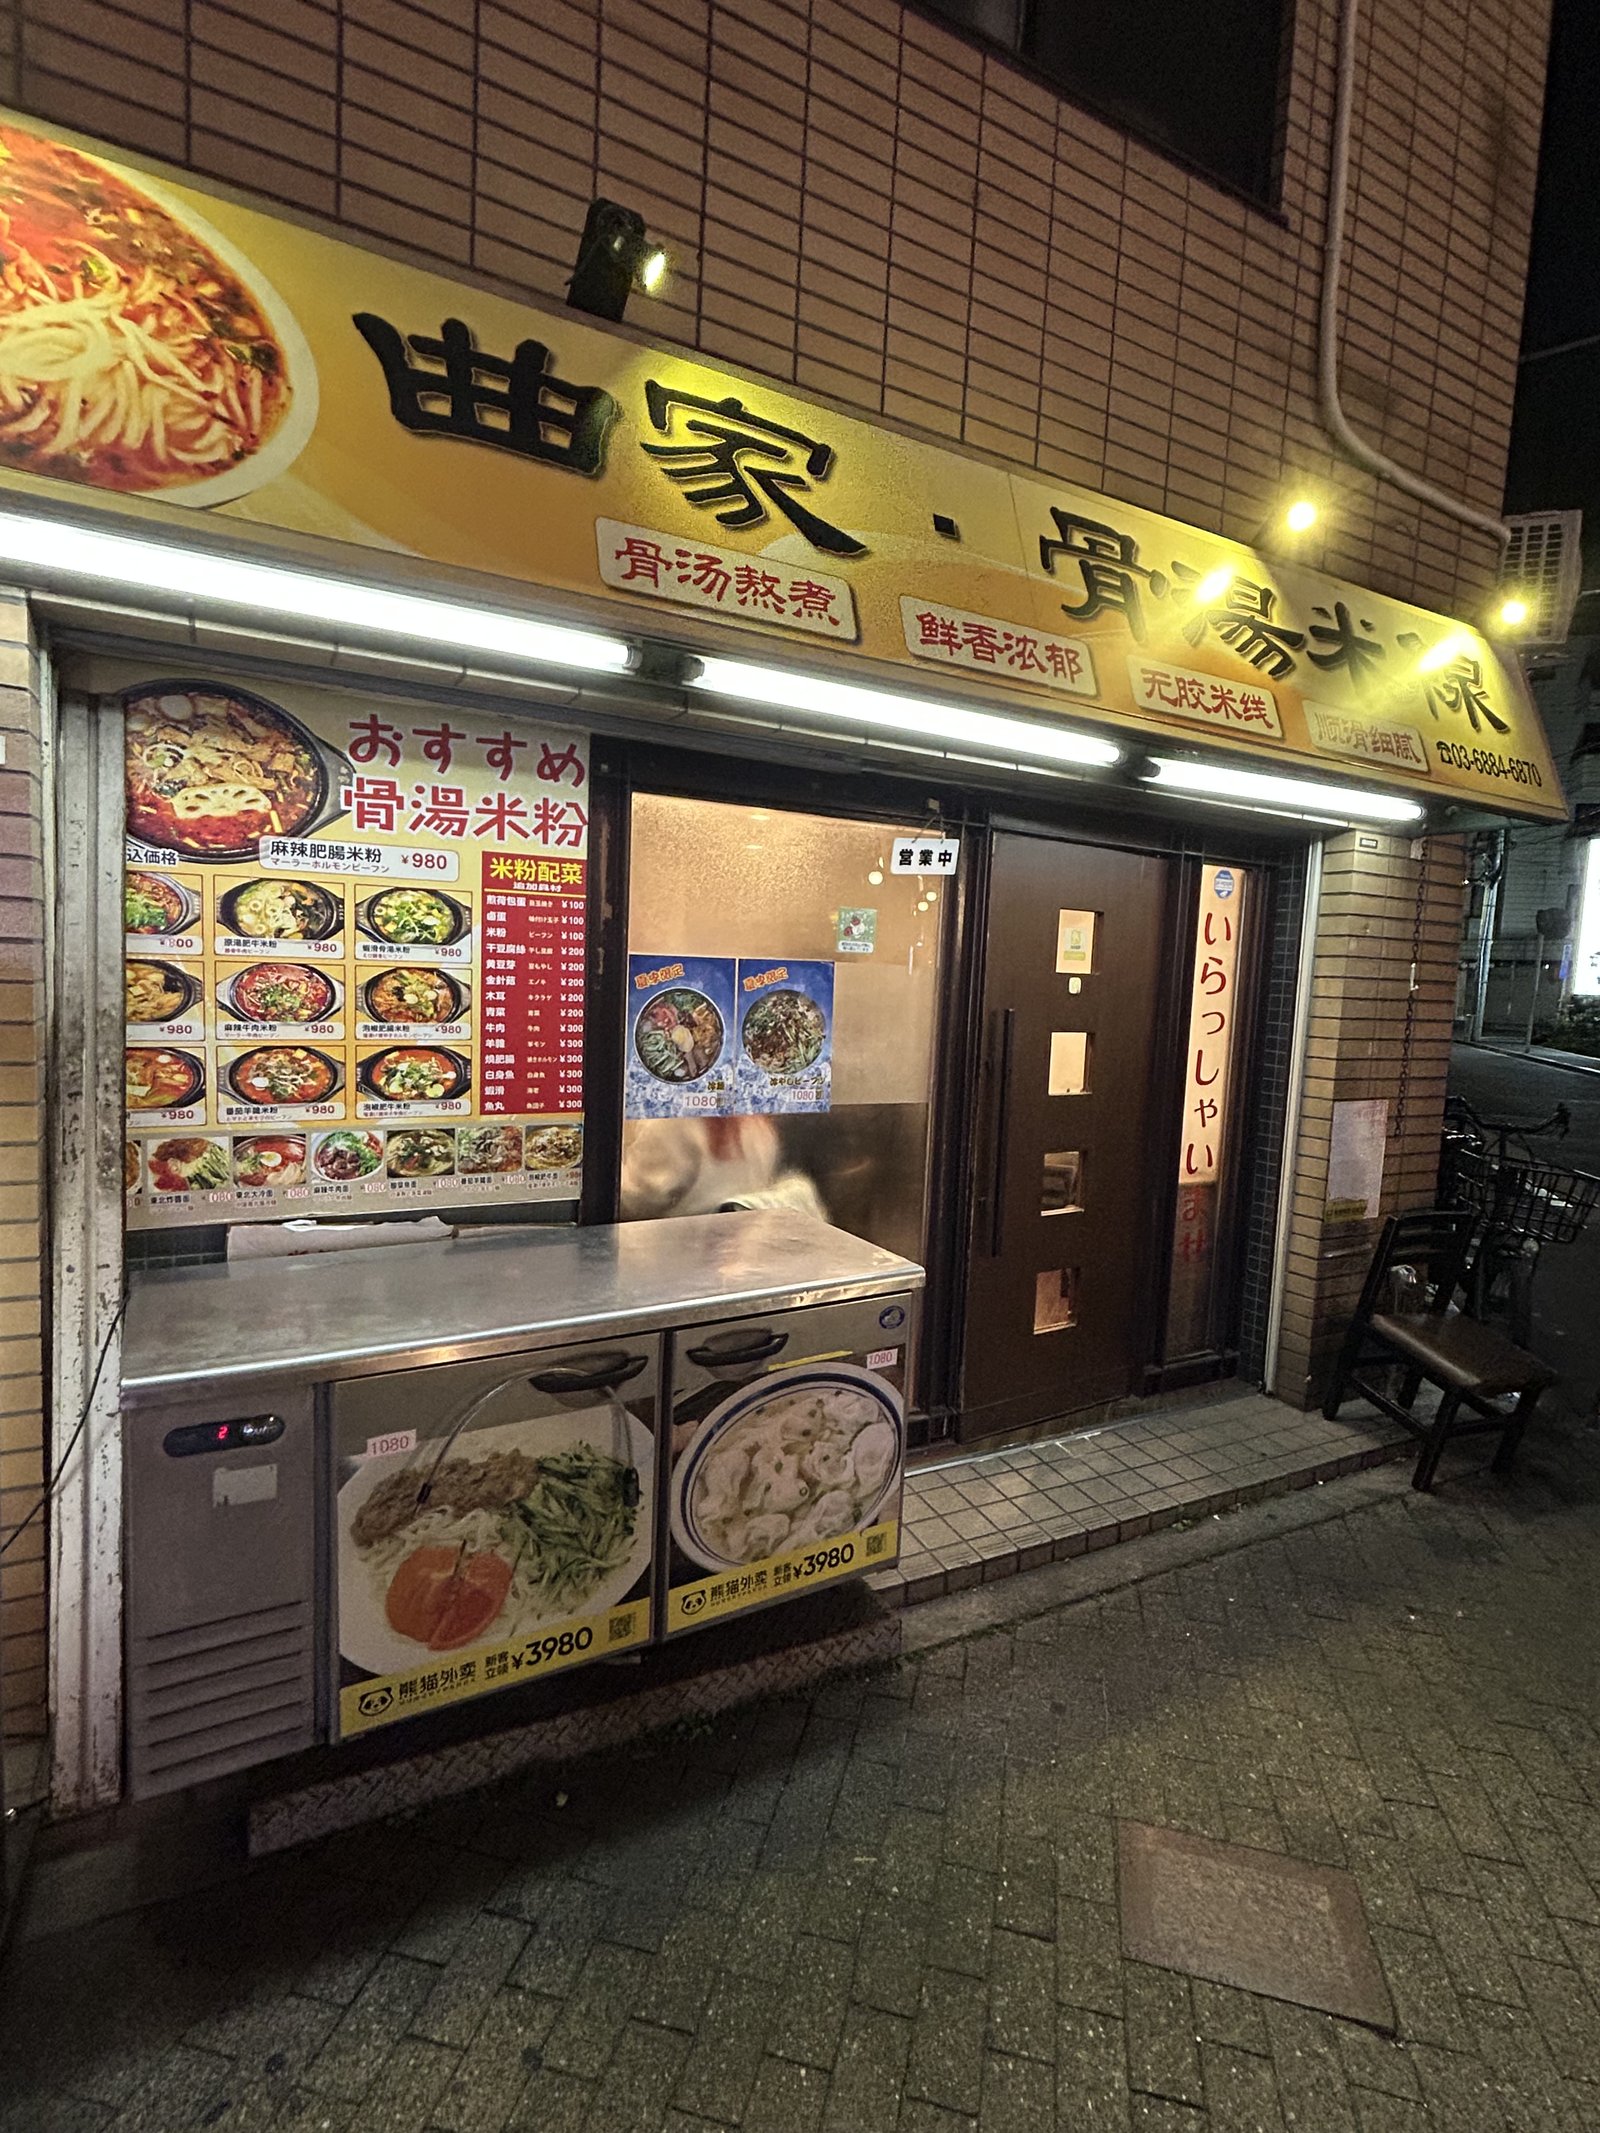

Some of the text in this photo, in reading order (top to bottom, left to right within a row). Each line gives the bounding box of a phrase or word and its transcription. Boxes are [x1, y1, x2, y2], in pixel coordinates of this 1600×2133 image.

[615, 537, 840, 626] 骨汤熬煮
[916, 612, 1083, 684] 鲜香浓郁
[1141, 668, 1274, 729] 无胶米线
[348, 714, 586, 788] おすすめ
[1451, 743, 1542, 787] 03-6884-6870
[344, 777, 588, 848] 骨湯米粉
[270, 841, 447, 869] 麻辣肥腸米粉 ¥980
[899, 848, 952, 867] 営業中
[271, 858, 390, 873] マーラーホルモンビーフン
[490, 857, 583, 884] 米粉配菜
[562, 900, 584, 910] ¥100
[562, 916, 584, 925] ¥100
[486, 927, 506, 938] 米粉
[561, 932, 584, 940] ¥100
[308, 943, 337, 952] ¥980
[435, 948, 462, 956] ¥980
[561, 948, 584, 956] ¥200
[561, 963, 584, 971] ¥200
[560, 978, 584, 986] ¥200
[486, 992, 506, 1000] 木耳
[560, 994, 584, 1002] ¥200
[486, 1007, 506, 1016] 青菜
[560, 1009, 584, 1017] ¥200
[160, 1025, 192, 1034] ¥980
[224, 1024, 334, 1034] 麻辣牛肉米粉 ¥980
[435, 1026, 462, 1034] ¥980
[486, 1023, 505, 1033] 牛肉
[560, 1024, 583, 1032] ¥300
[560, 1039, 583, 1048] ¥300
[560, 1054, 582, 1063] ¥300
[485, 1070, 514, 1080] 白身魚
[560, 1070, 582, 1078] ¥300
[770, 1077, 825, 1086] 冷やしビーフン
[559, 1085, 582, 1093] ¥300
[306, 1106, 335, 1114] ¥980
[436, 1102, 462, 1110] ¥980
[485, 1102, 504, 1111] 魚丸
[559, 1100, 582, 1108] ¥300
[161, 1110, 194, 1119] ¥980
[869, 1352, 893, 1365] 1080
[370, 1435, 411, 1456] 1080
[710, 1570, 767, 1602] 熊猫外卖
[794, 1543, 854, 1579] ¥3980
[399, 1661, 477, 1699] 熊猫外卖
[512, 1627, 593, 1670] ¥3980
